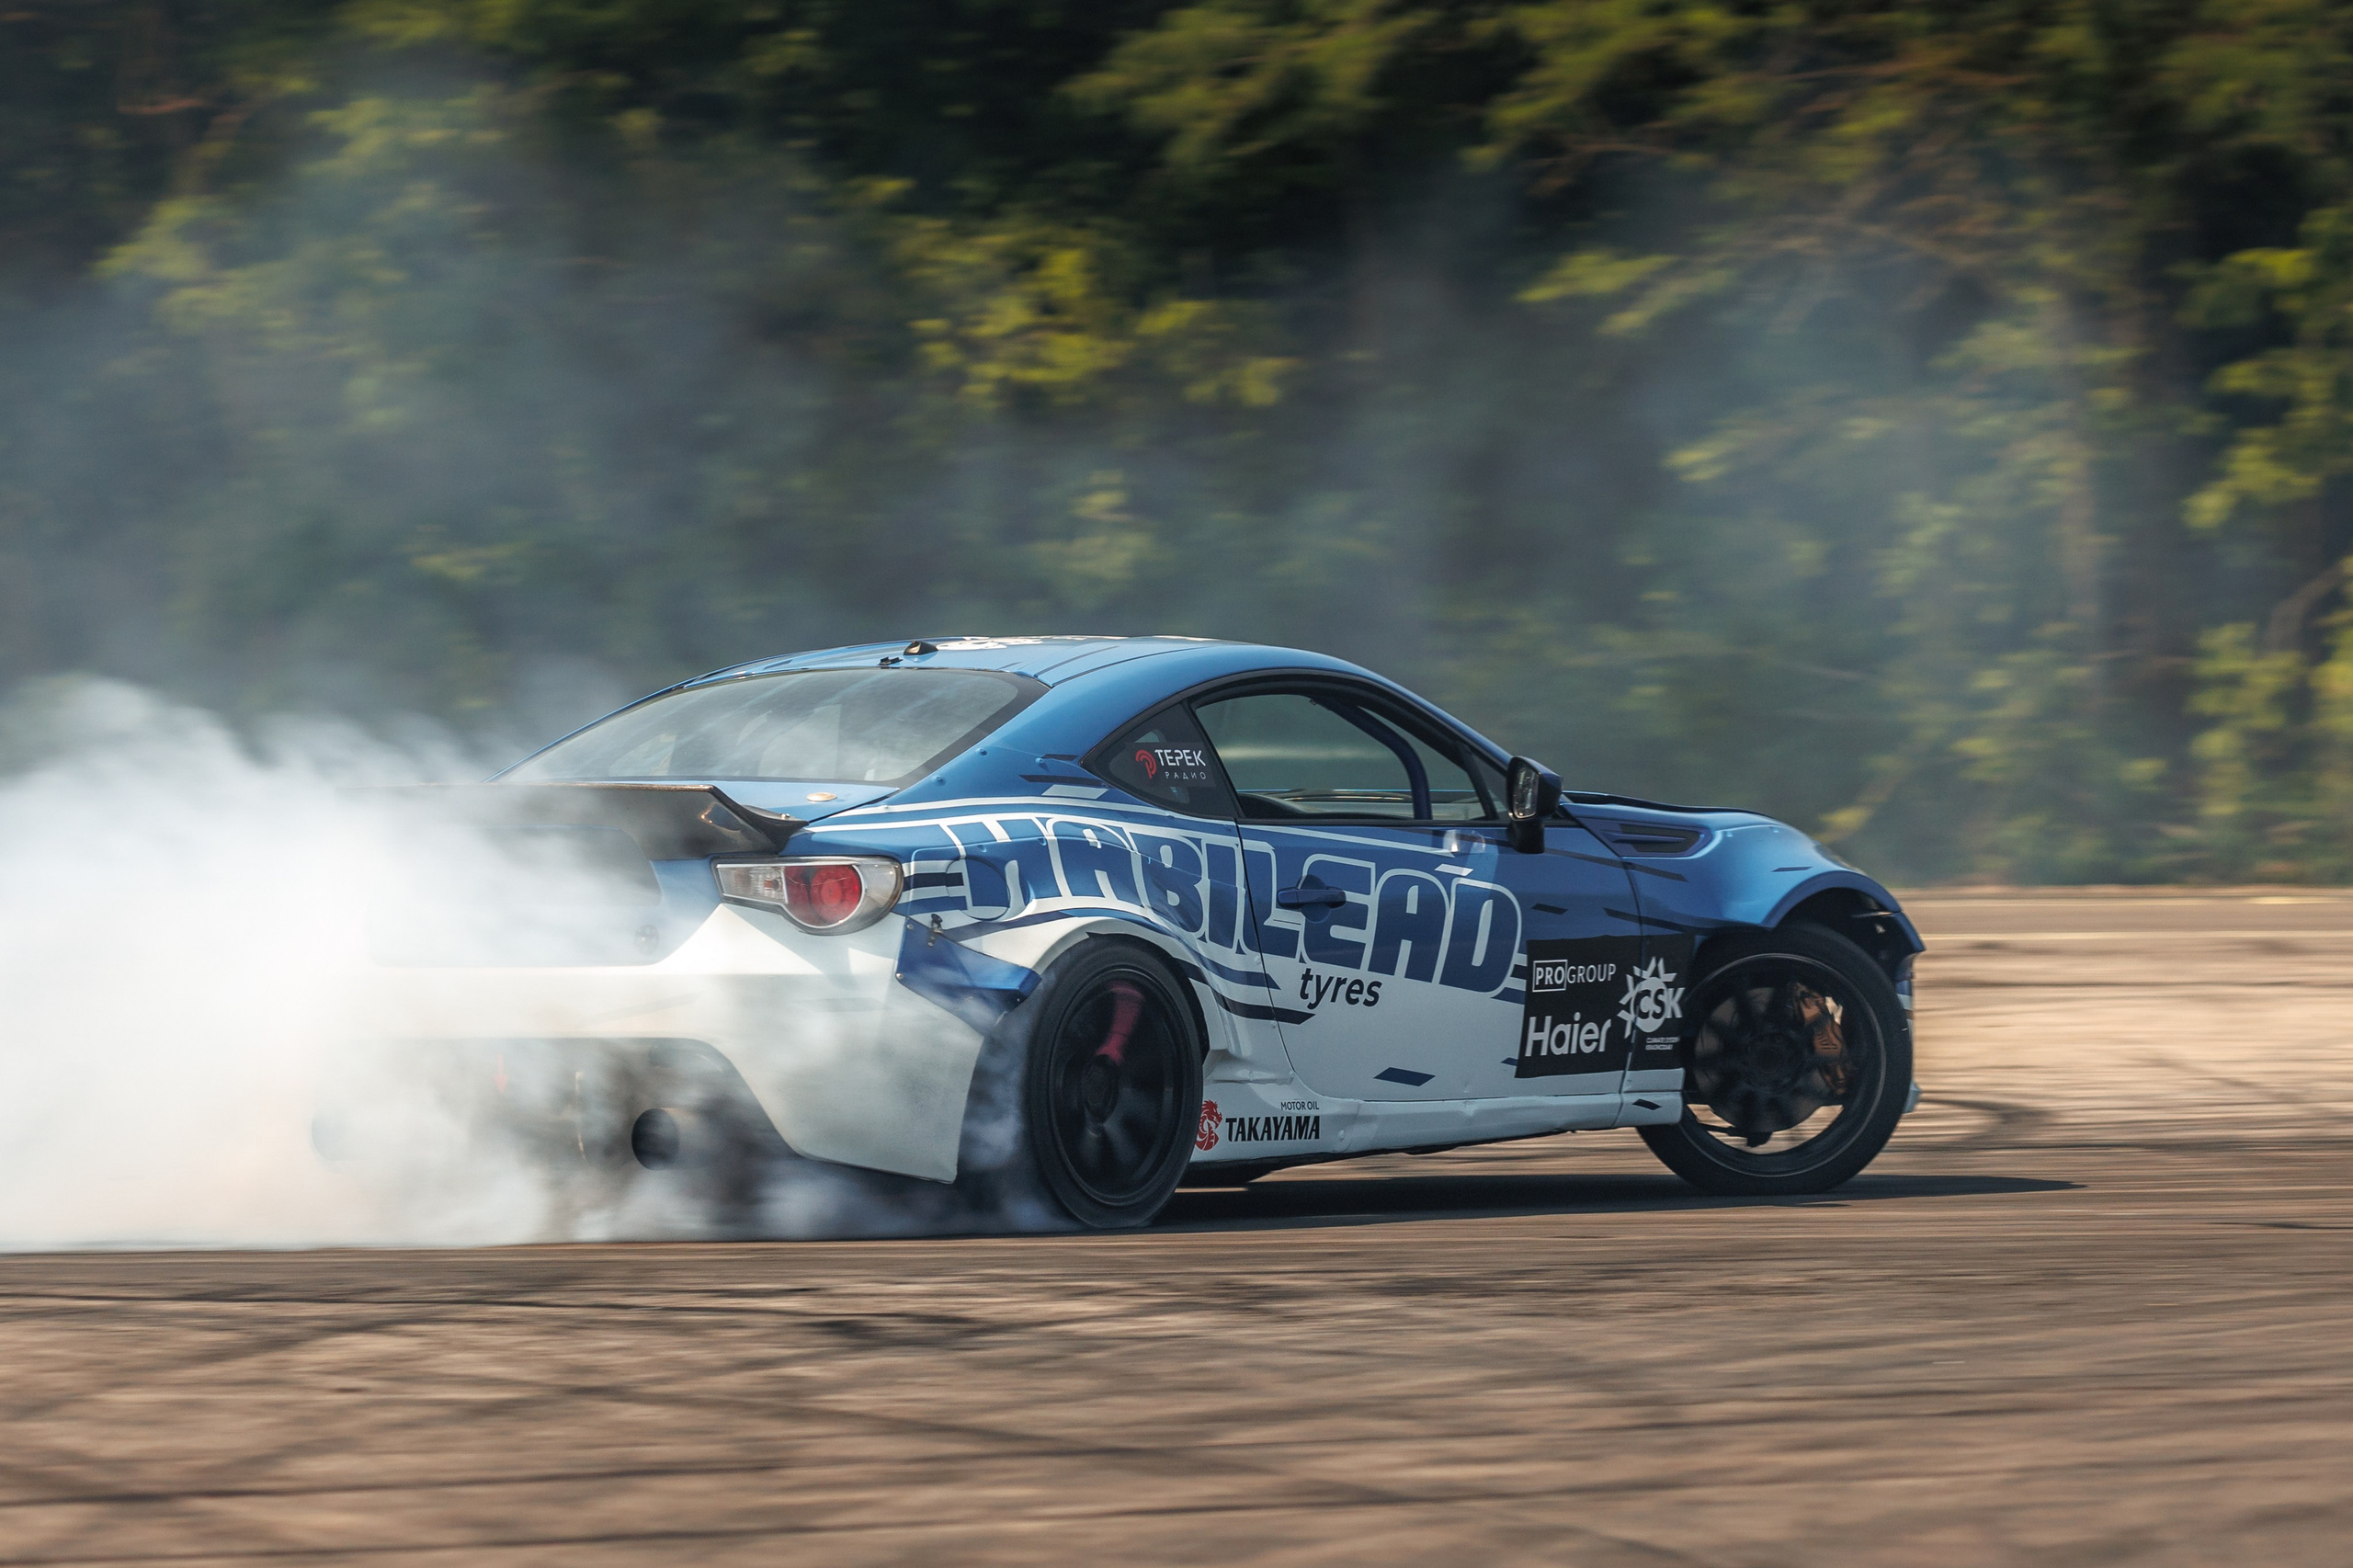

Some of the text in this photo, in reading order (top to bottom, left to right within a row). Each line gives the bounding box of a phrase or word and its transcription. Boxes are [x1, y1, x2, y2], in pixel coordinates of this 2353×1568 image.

[1154, 749, 1207, 767] ТЕРЕК
[1165, 771, 1207, 780] РАДИО
[941, 816, 1523, 997] HABILEAD
[1299, 967, 1382, 1008] tyres
[1524, 1011, 1612, 1057] Haier
[1280, 1100, 1320, 1111] MOTOR OIL
[1225, 1115, 1320, 1142] TAKAYAMA
